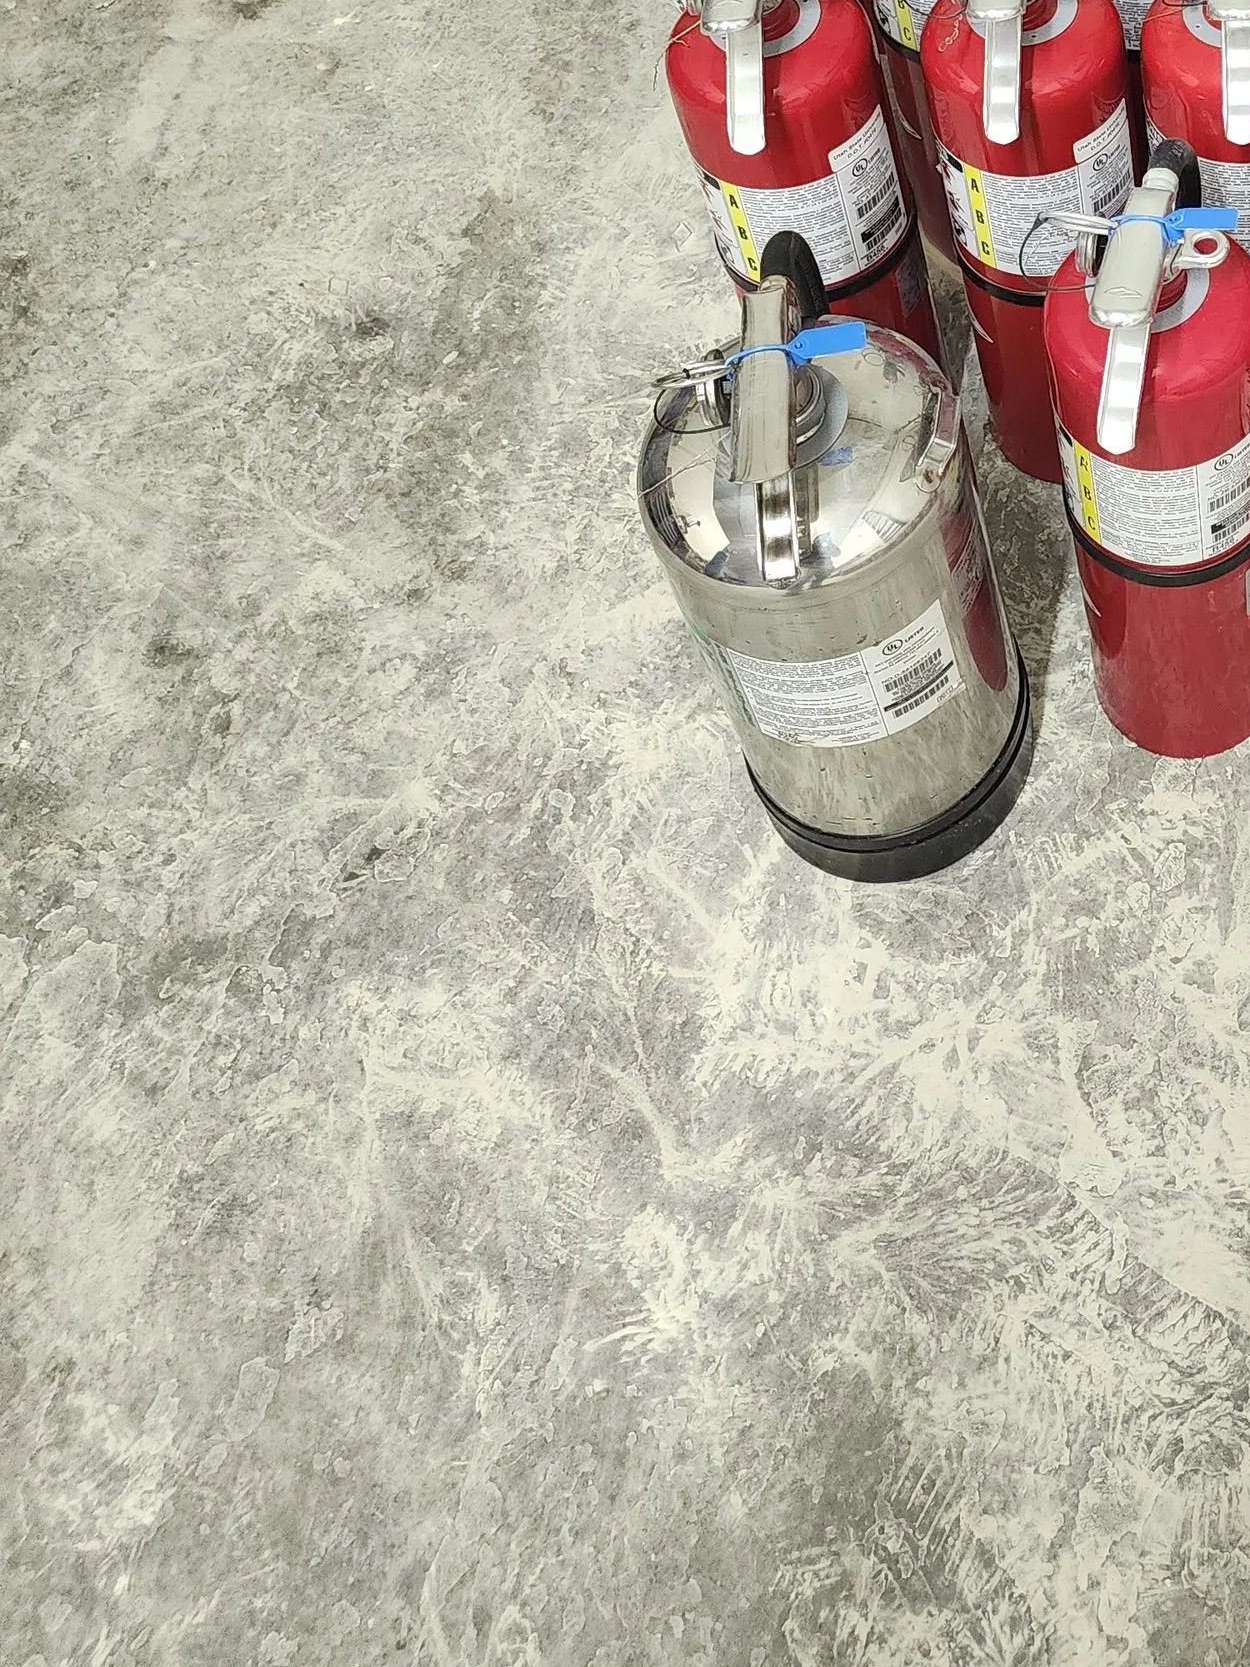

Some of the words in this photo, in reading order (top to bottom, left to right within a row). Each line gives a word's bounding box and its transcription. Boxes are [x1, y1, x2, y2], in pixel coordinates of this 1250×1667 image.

[903, 27, 912, 42] C
[970, 178, 980, 194] A
[729, 194, 739, 209] A
[975, 209, 985, 225] B
[737, 225, 748, 241] B
[981, 240, 991, 256] C
[747, 256, 758, 272] C
[1083, 486, 1092, 501] B
[1087, 515, 1096, 531] C
